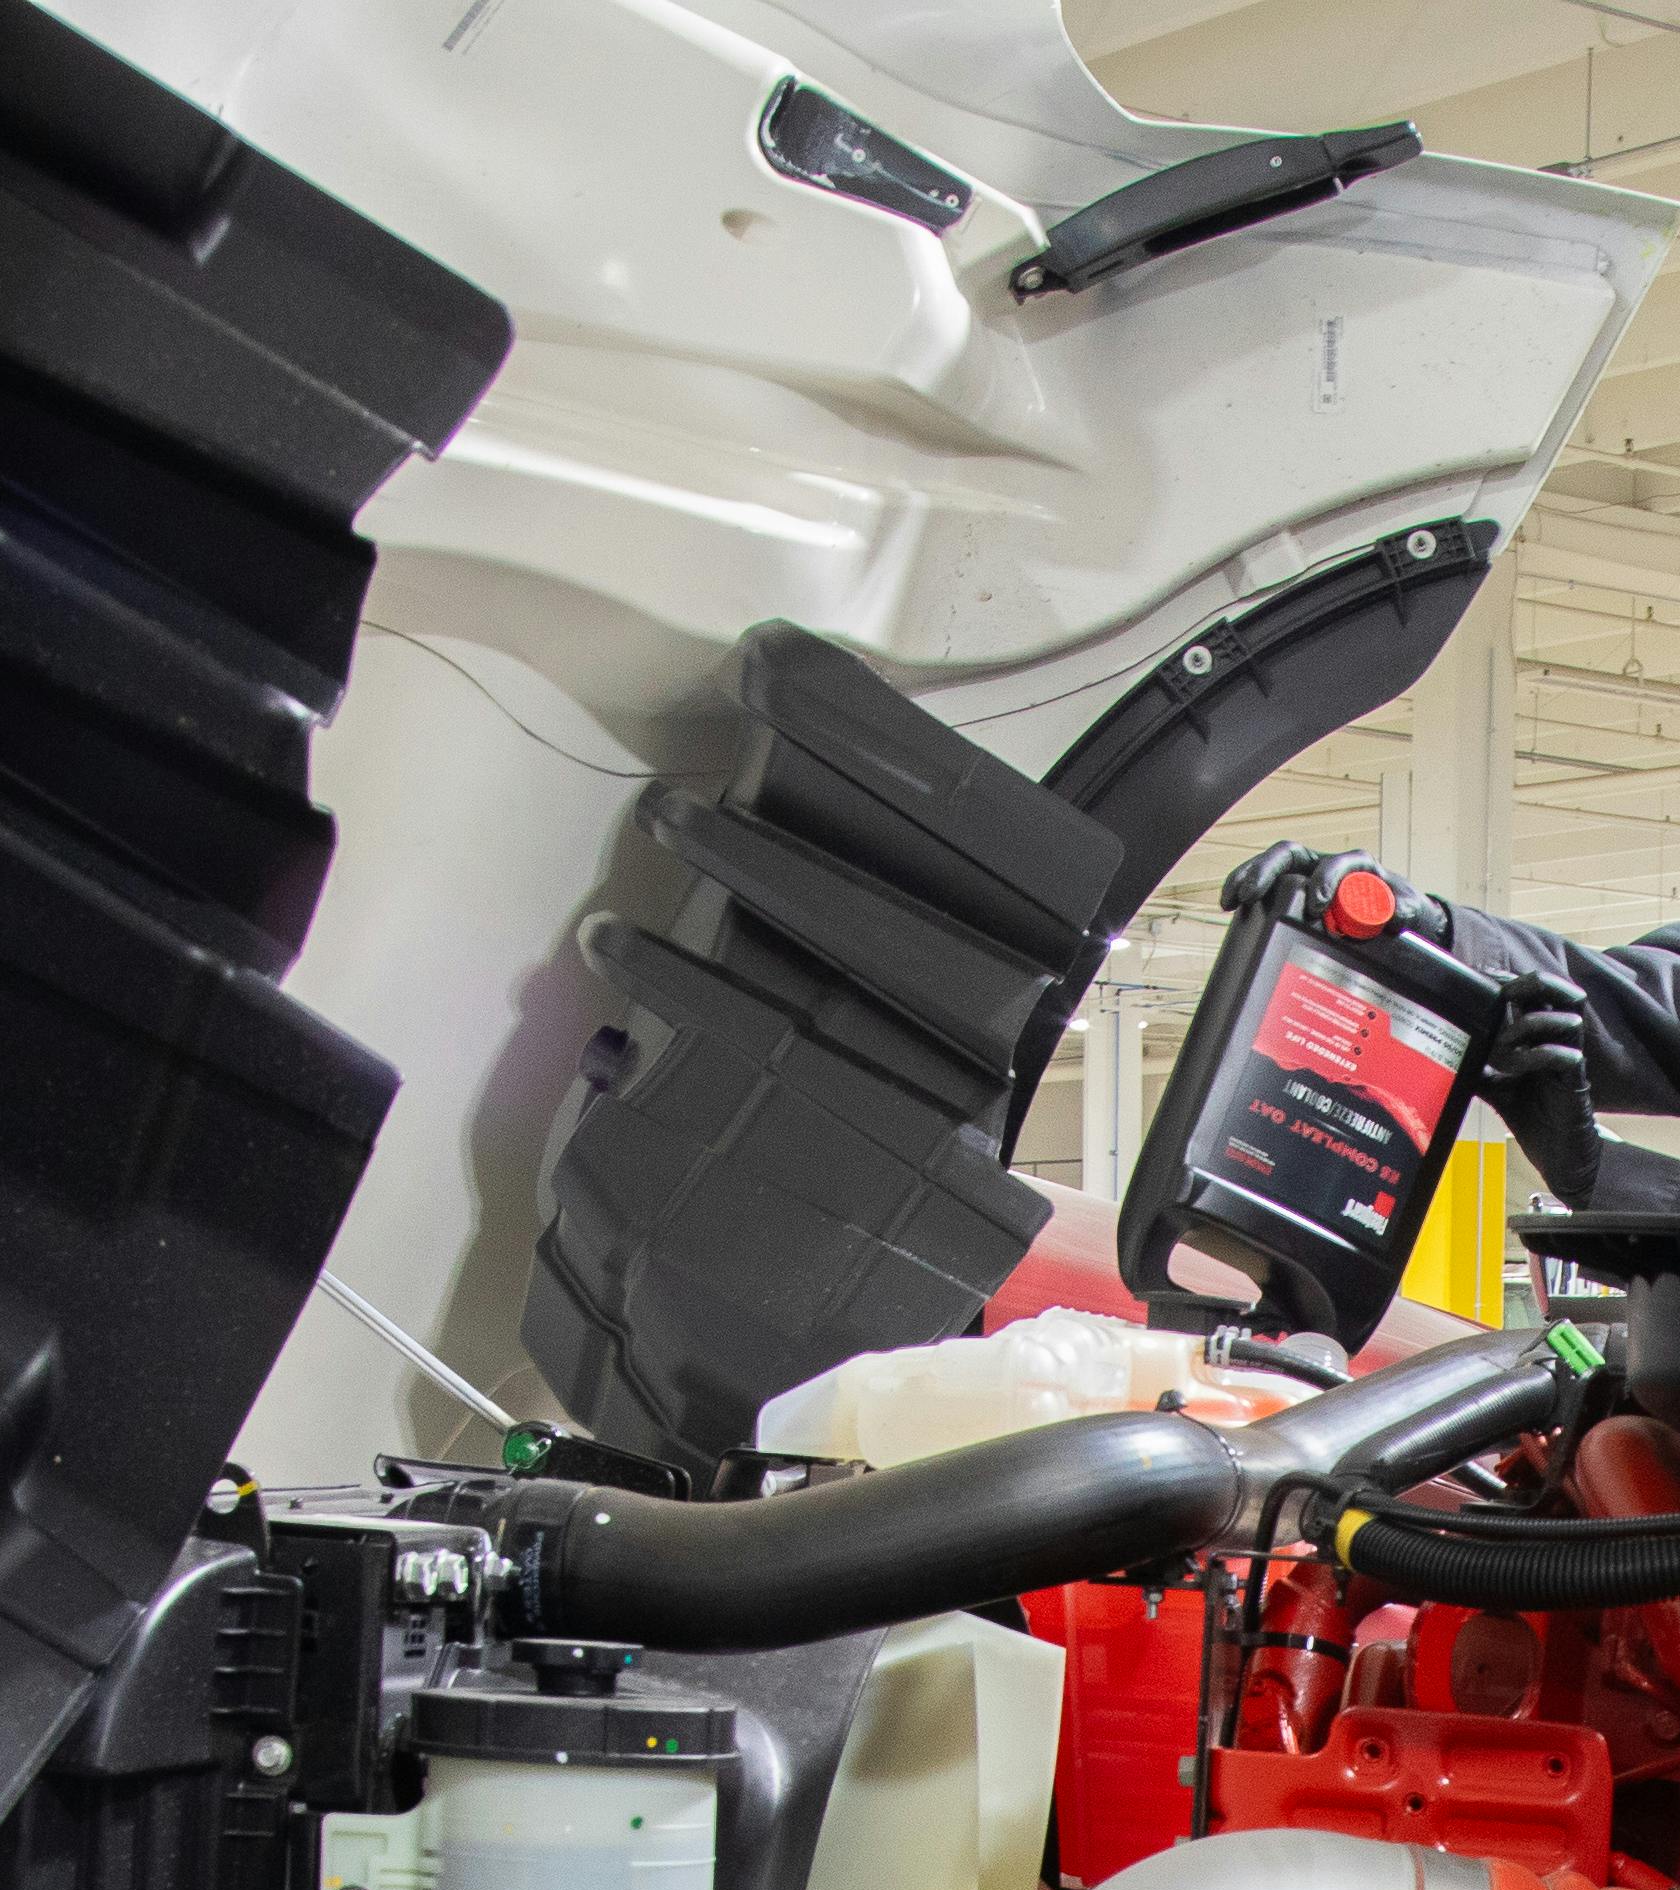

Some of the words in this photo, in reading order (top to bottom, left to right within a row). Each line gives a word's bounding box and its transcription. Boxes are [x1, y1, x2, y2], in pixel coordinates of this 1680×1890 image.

[1248, 1098, 1287, 1124] OAT
[1282, 1078, 1394, 1146] ANTIFREEZE/COOLANT
[1288, 1118, 1379, 1174] COMPLEAT
